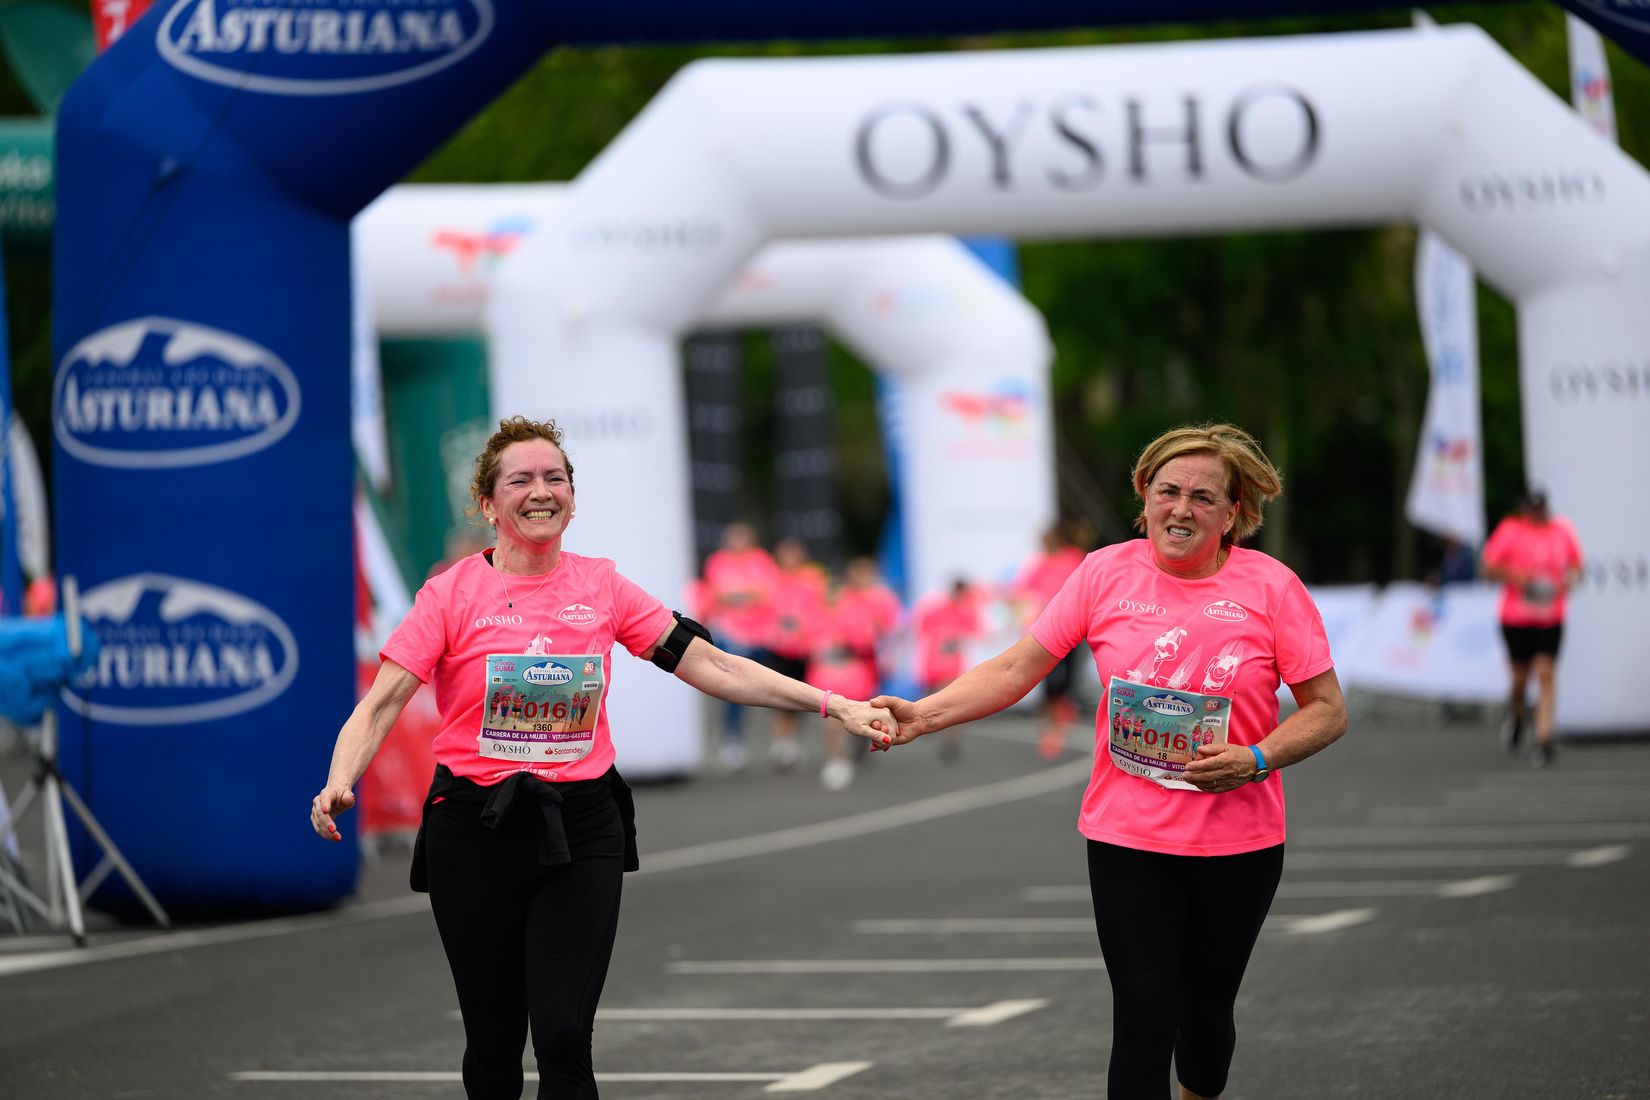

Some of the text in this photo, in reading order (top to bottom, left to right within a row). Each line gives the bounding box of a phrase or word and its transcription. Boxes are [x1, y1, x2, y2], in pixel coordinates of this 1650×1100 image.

[175, 0, 466, 53] ASTURIANA
[853, 81, 1322, 201] OYSHO
[1549, 359, 1650, 405] OYSH
[64, 371, 278, 432] ASTURIANA
[1119, 599, 1166, 617] OYSHO
[475, 614, 522, 629] OYSHO
[526, 670, 570, 681] ASTURIANA
[523, 701, 567, 719] 016
[1146, 699, 1191, 713] ASTURIANA
[485, 730, 511, 738] CARRERA
[533, 723, 553, 732] 1360
[1143, 728, 1187, 751] 016
[493, 743, 531, 755] OYSHO
[1112, 745, 1133, 759] CARRERA
[1141, 756, 1148, 764] LA
[1149, 759, 1168, 767] MUJER
[1158, 752, 1168, 760] 18
[538, 768, 558, 779] MUJER
[1120, 759, 1151, 777] OYSHO
